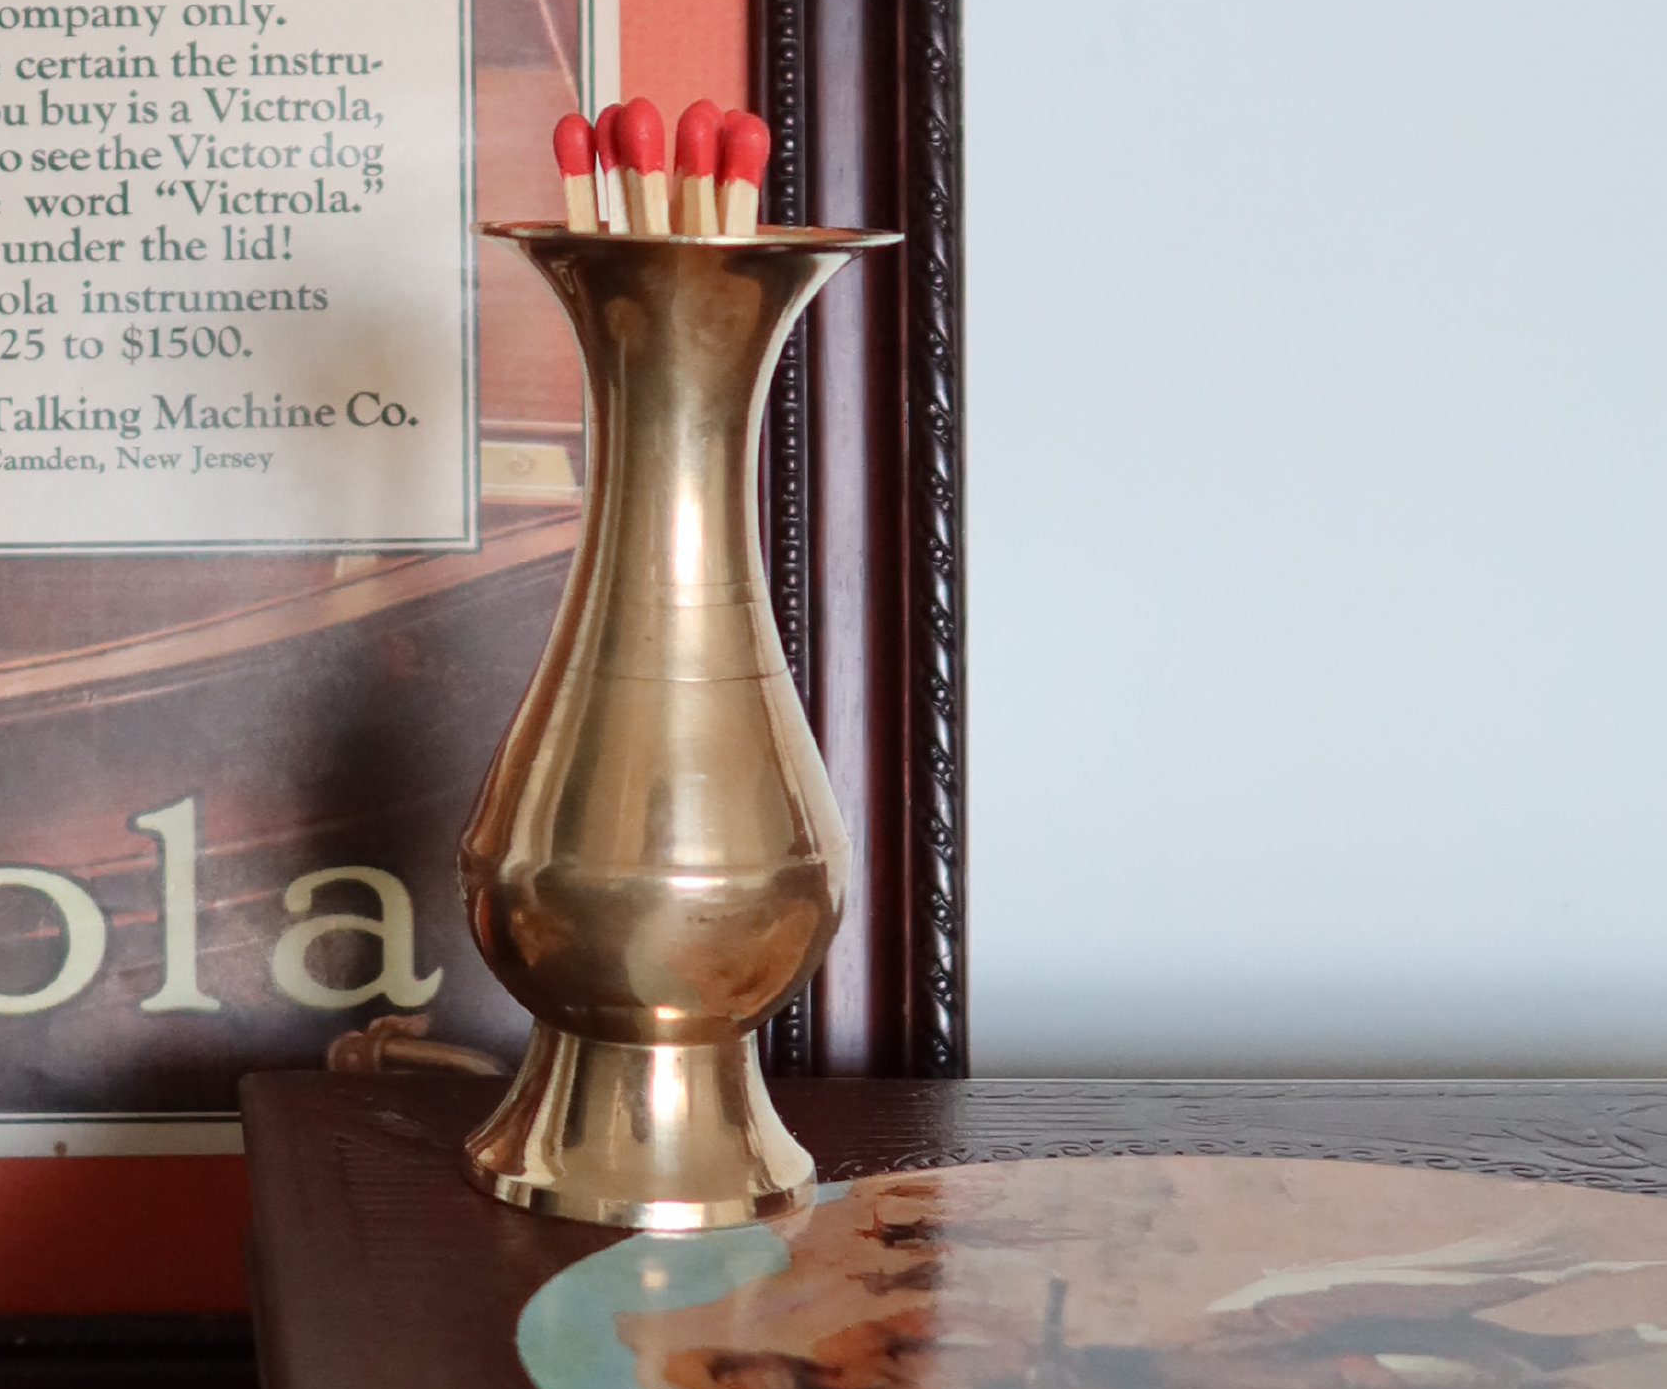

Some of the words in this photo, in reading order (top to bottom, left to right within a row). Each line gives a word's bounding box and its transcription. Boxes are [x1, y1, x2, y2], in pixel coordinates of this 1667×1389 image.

[14, 44, 160, 81] certain
[170, 40, 238, 79] the
[248, 42, 383, 77] instru-
[38, 88, 117, 134] buy
[127, 89, 159, 125] is
[170, 100, 193, 124] a
[202, 85, 383, 125] Victrola,
[30, 148, 91, 173] see
[96, 133, 162, 171] the
[168, 133, 302, 170] Victor
[310, 131, 384, 177] dog
[23, 179, 133, 218] word
[155, 177, 384, 216] “Victrola.”
[1, 225, 126, 265] under
[140, 224, 207, 262] the
[222, 223, 293, 261] lid!
[81, 279, 328, 314] instruments
[63, 333, 104, 360] to
[121, 324, 253, 365] $1500.
[152, 392, 336, 430] Machine
[346, 391, 420, 428] Co.
[116, 446, 181, 469] New
[192, 445, 269, 474] Jersey
